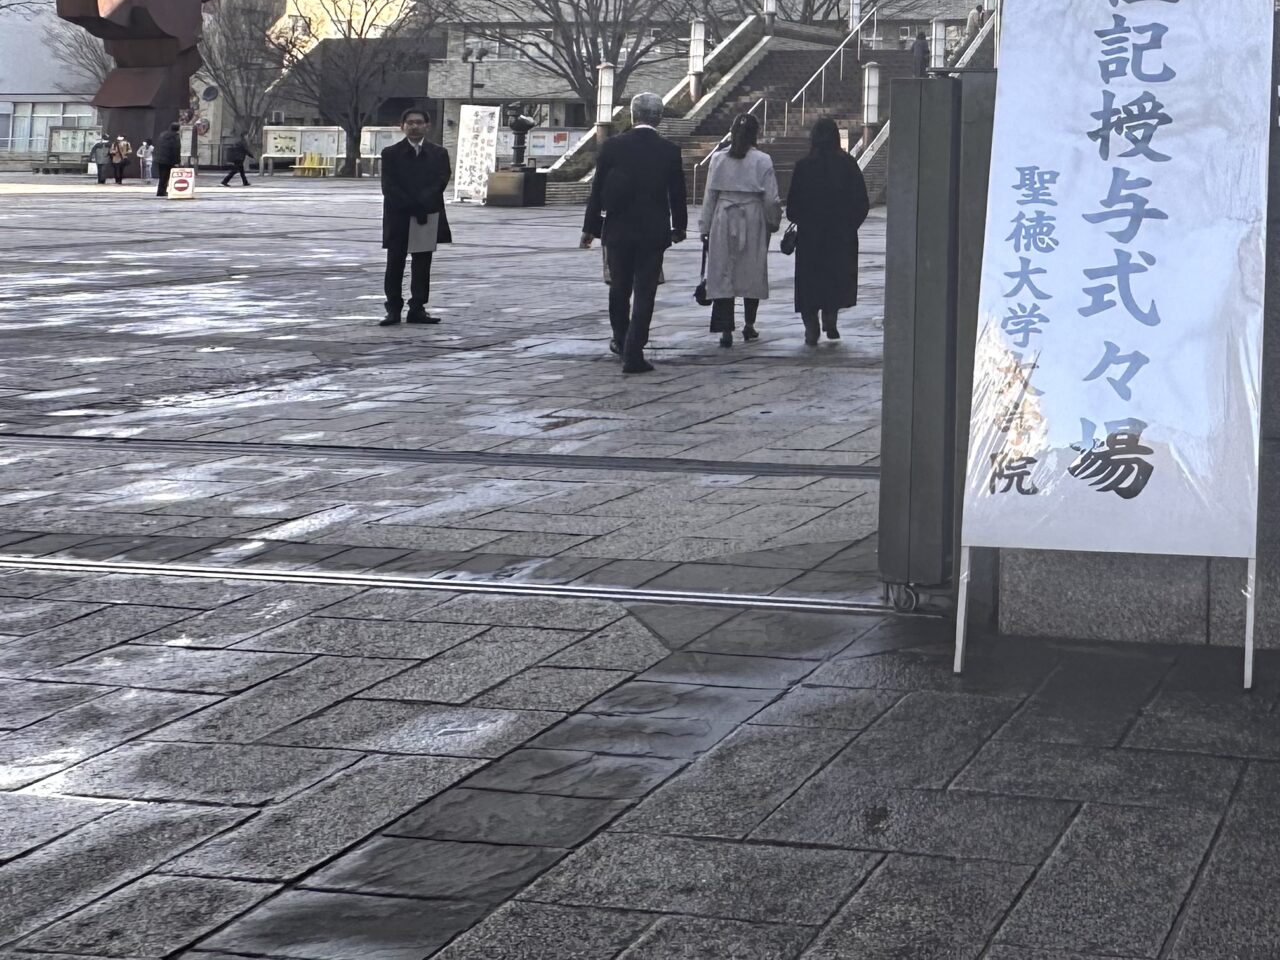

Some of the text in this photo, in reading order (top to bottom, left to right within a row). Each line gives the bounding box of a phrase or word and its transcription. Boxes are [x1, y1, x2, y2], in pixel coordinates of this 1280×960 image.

[988, 165, 1060, 496] 聖徳大学大院
